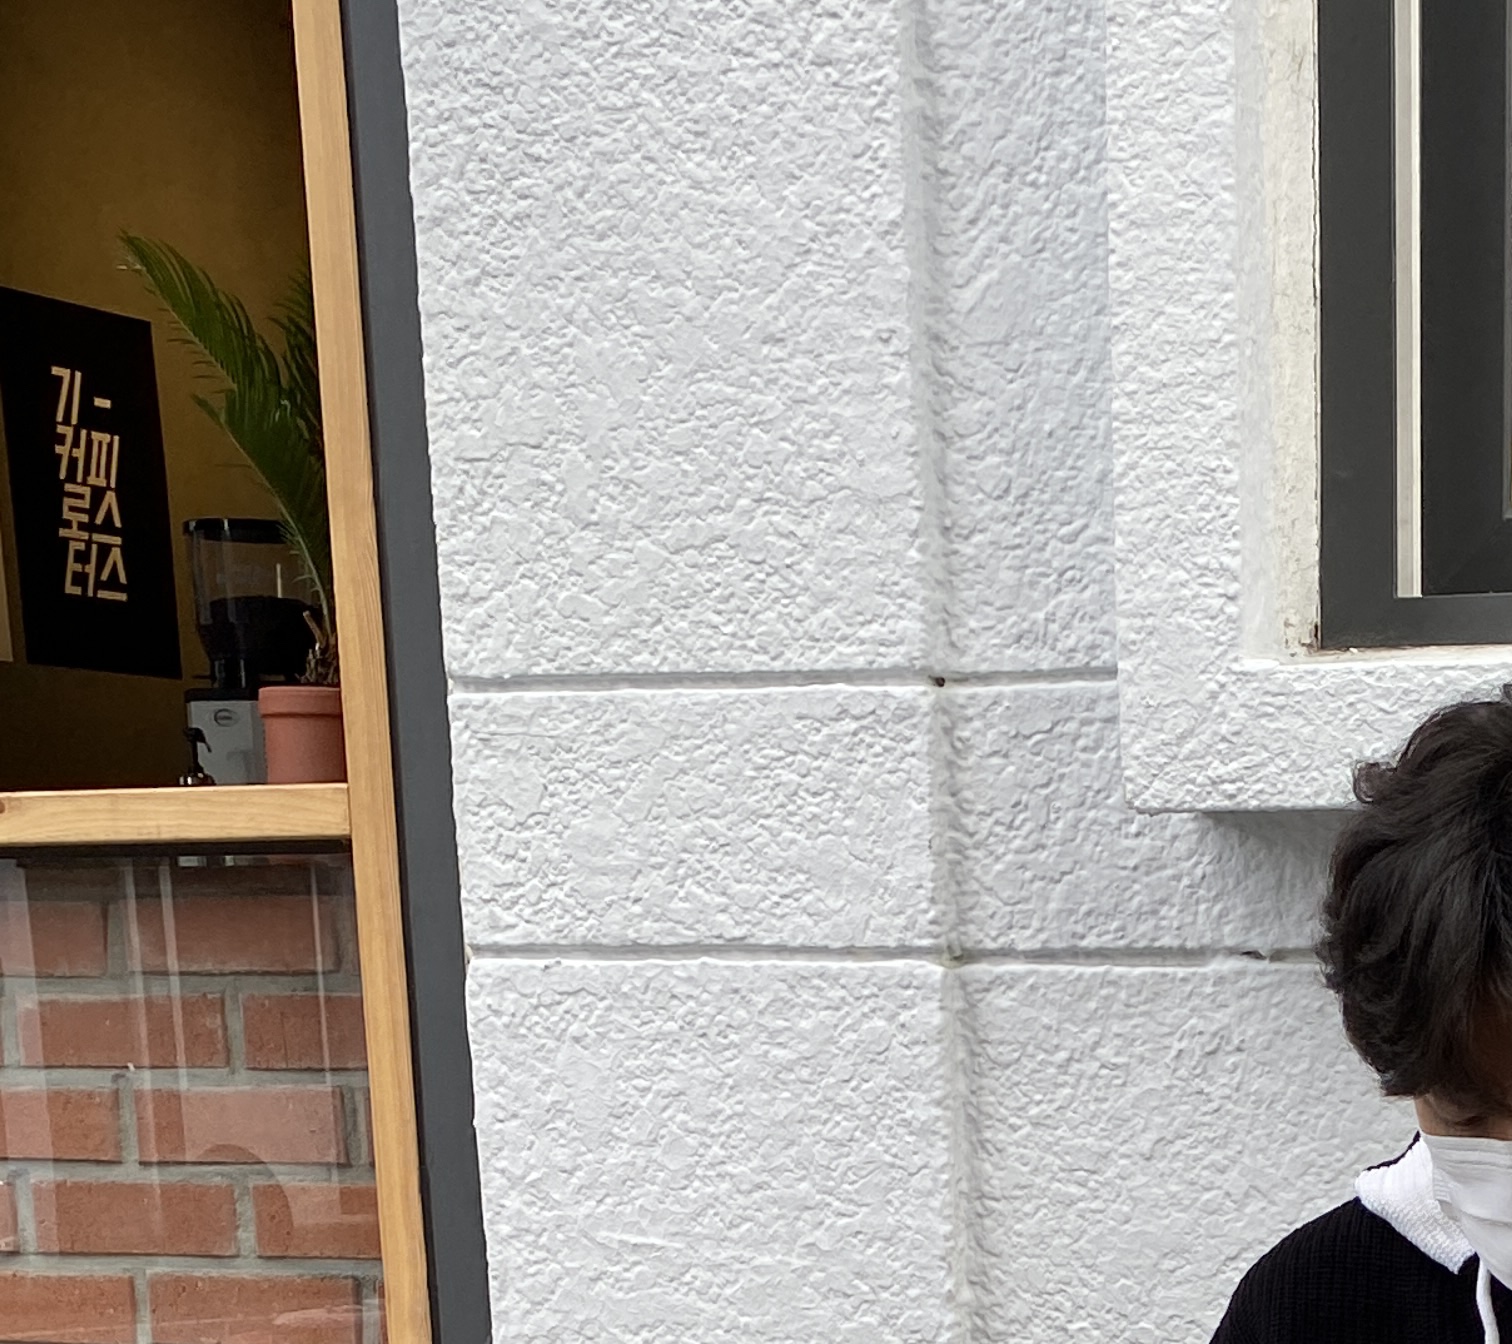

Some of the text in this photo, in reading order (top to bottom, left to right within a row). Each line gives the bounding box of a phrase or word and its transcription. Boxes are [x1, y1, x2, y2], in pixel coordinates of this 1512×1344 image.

[54, 424, 120, 488] 커피
[58, 483, 122, 545] 로스
[64, 539, 128, 601] 터스
